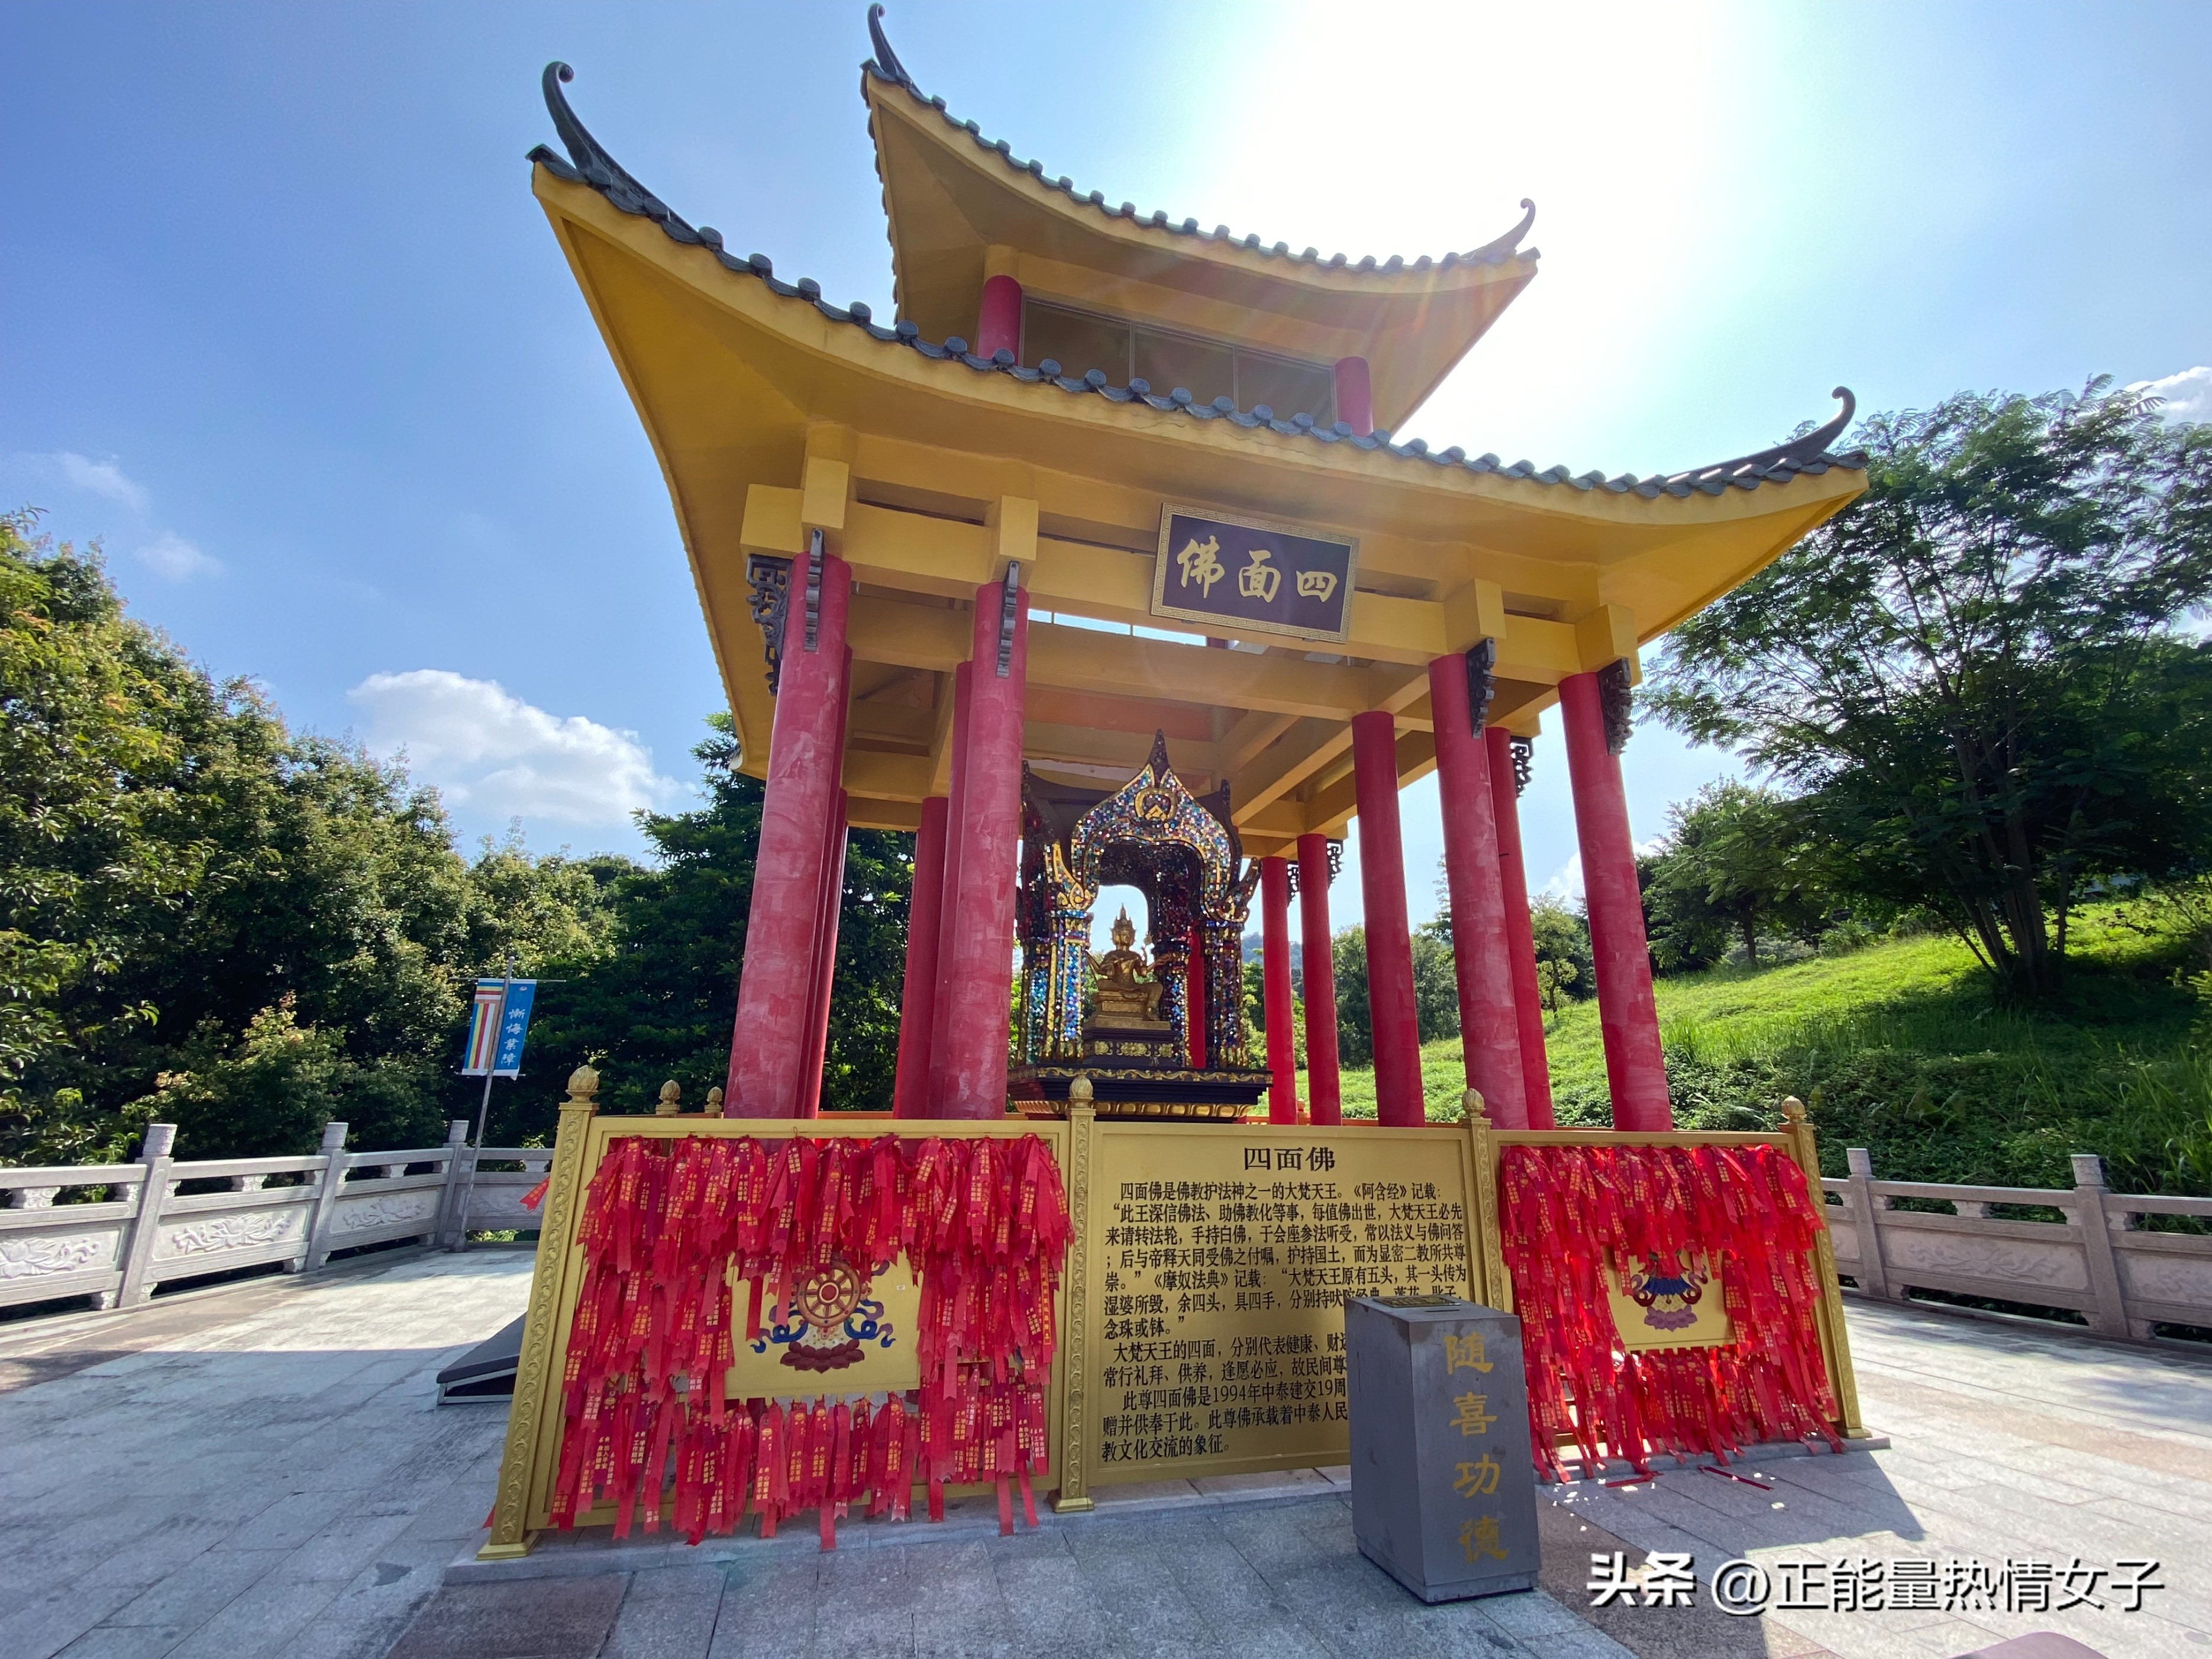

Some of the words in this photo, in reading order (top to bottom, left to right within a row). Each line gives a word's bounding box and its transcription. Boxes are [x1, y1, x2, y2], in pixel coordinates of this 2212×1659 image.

[1244, 1147, 1335, 1171] 四面佛
[1103, 1354, 1347, 1388] 常行礼拜、供养，逢愿必应，故民间尊
[1102, 1434, 1229, 1463] 教文化交流的象征。
[1443, 1332, 1509, 1564] 随喜功德
